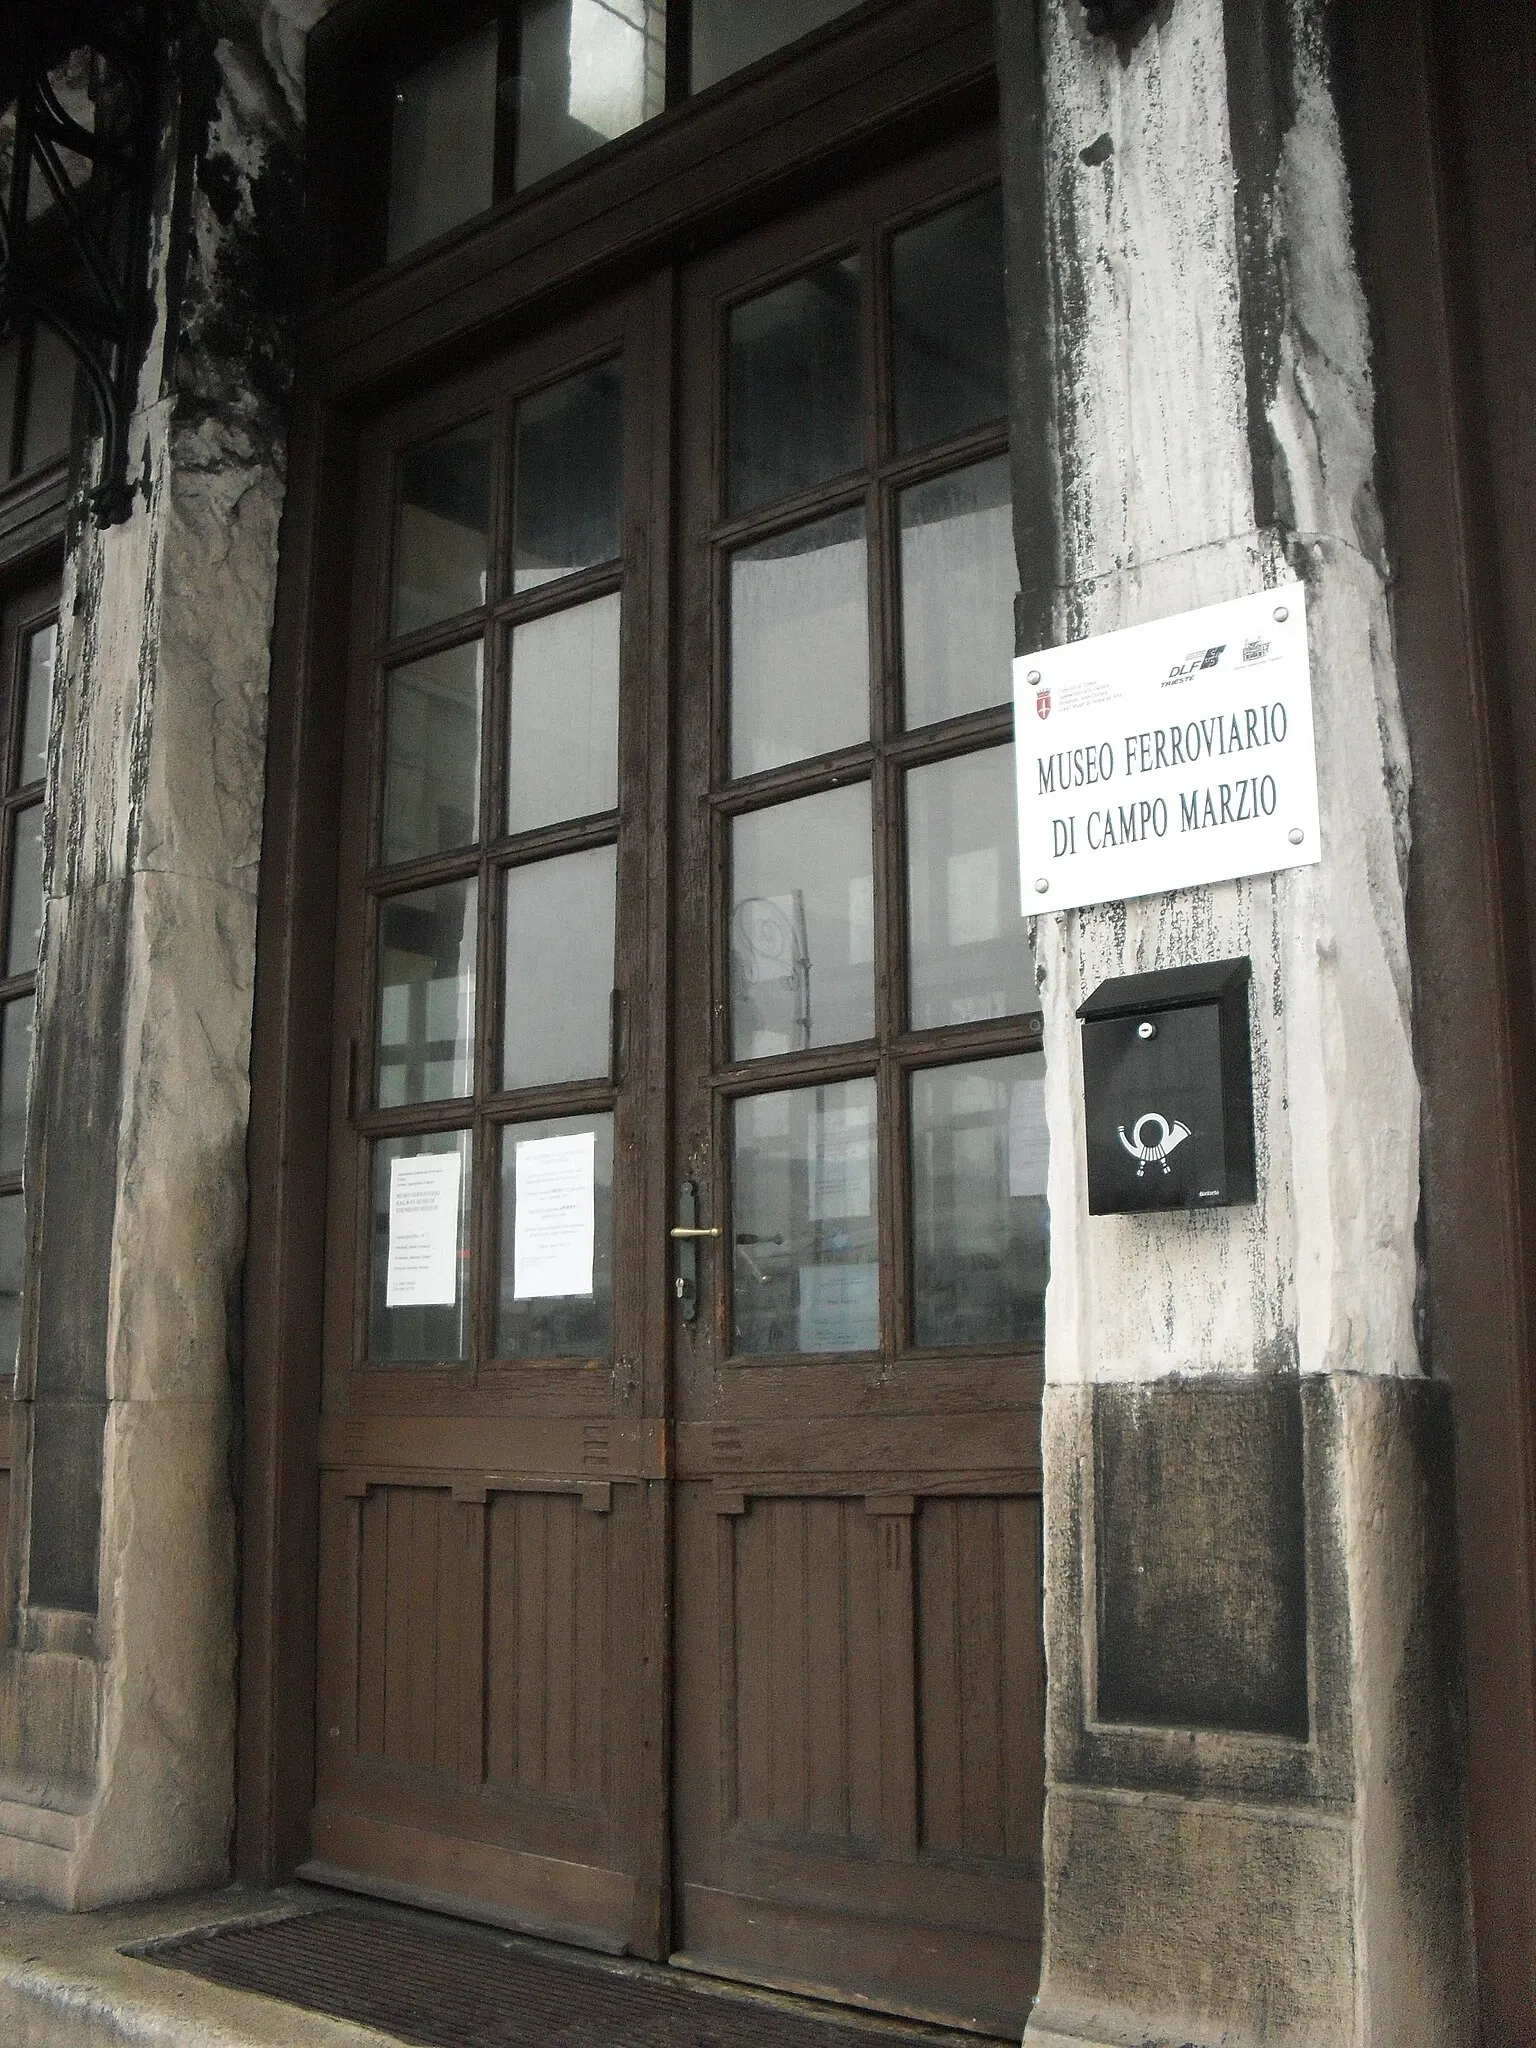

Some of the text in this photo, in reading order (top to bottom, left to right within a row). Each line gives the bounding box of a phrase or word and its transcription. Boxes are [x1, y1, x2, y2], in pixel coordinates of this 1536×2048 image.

[1160, 675, 1196, 688] TRIESTE
[1168, 660, 1202, 678] DLF
[1037, 702, 1288, 795] MUSEO FERROVIARIO
[1052, 775, 1277, 858] DI CAMPO MARZIO
